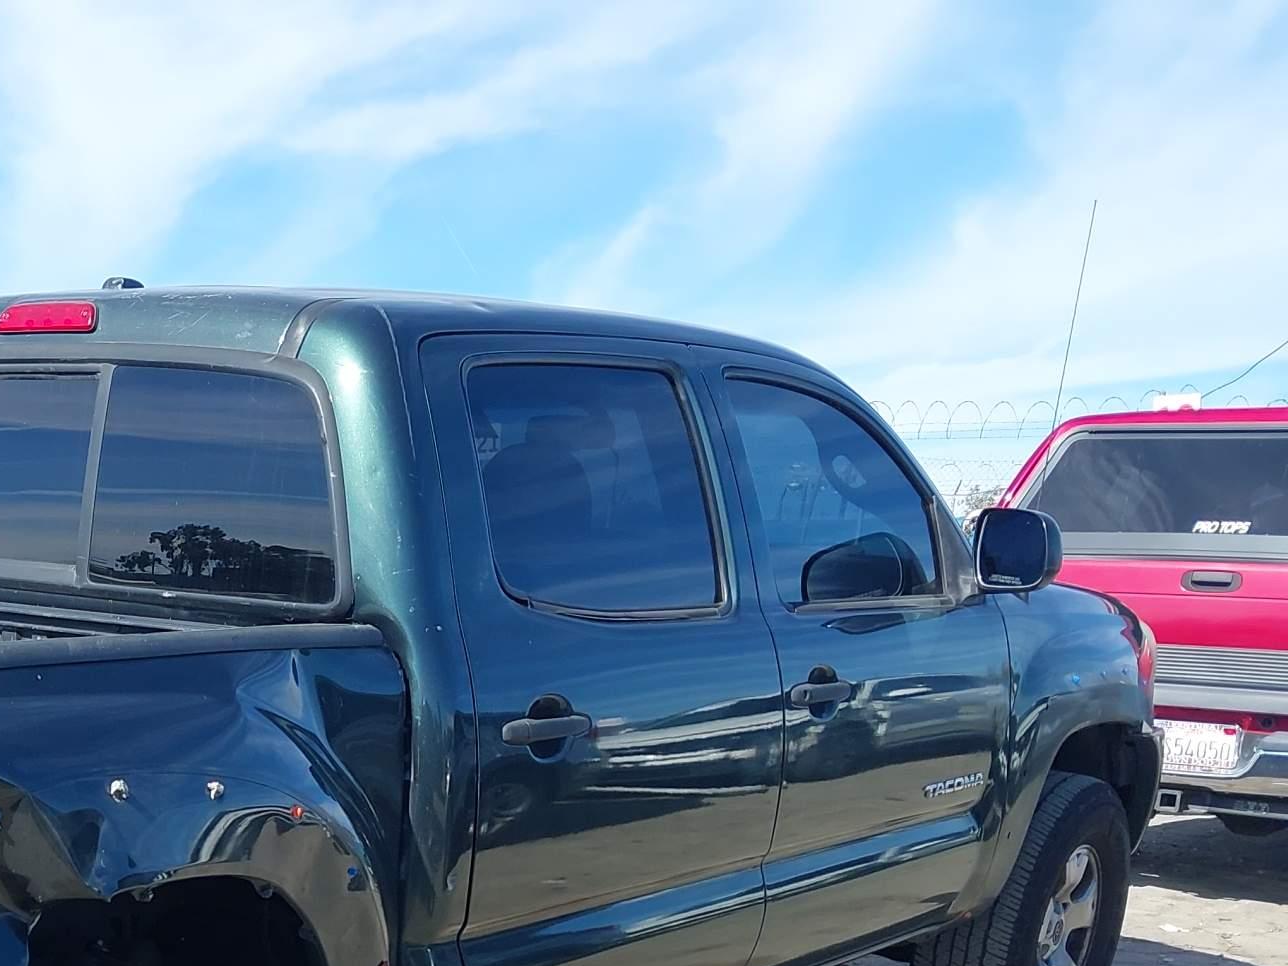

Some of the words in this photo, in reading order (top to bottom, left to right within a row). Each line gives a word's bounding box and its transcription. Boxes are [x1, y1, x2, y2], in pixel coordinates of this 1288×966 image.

[1192, 520, 1219, 534] PRO
[1219, 520, 1252, 535] TOPS
[923, 772, 984, 798] TACOMA
